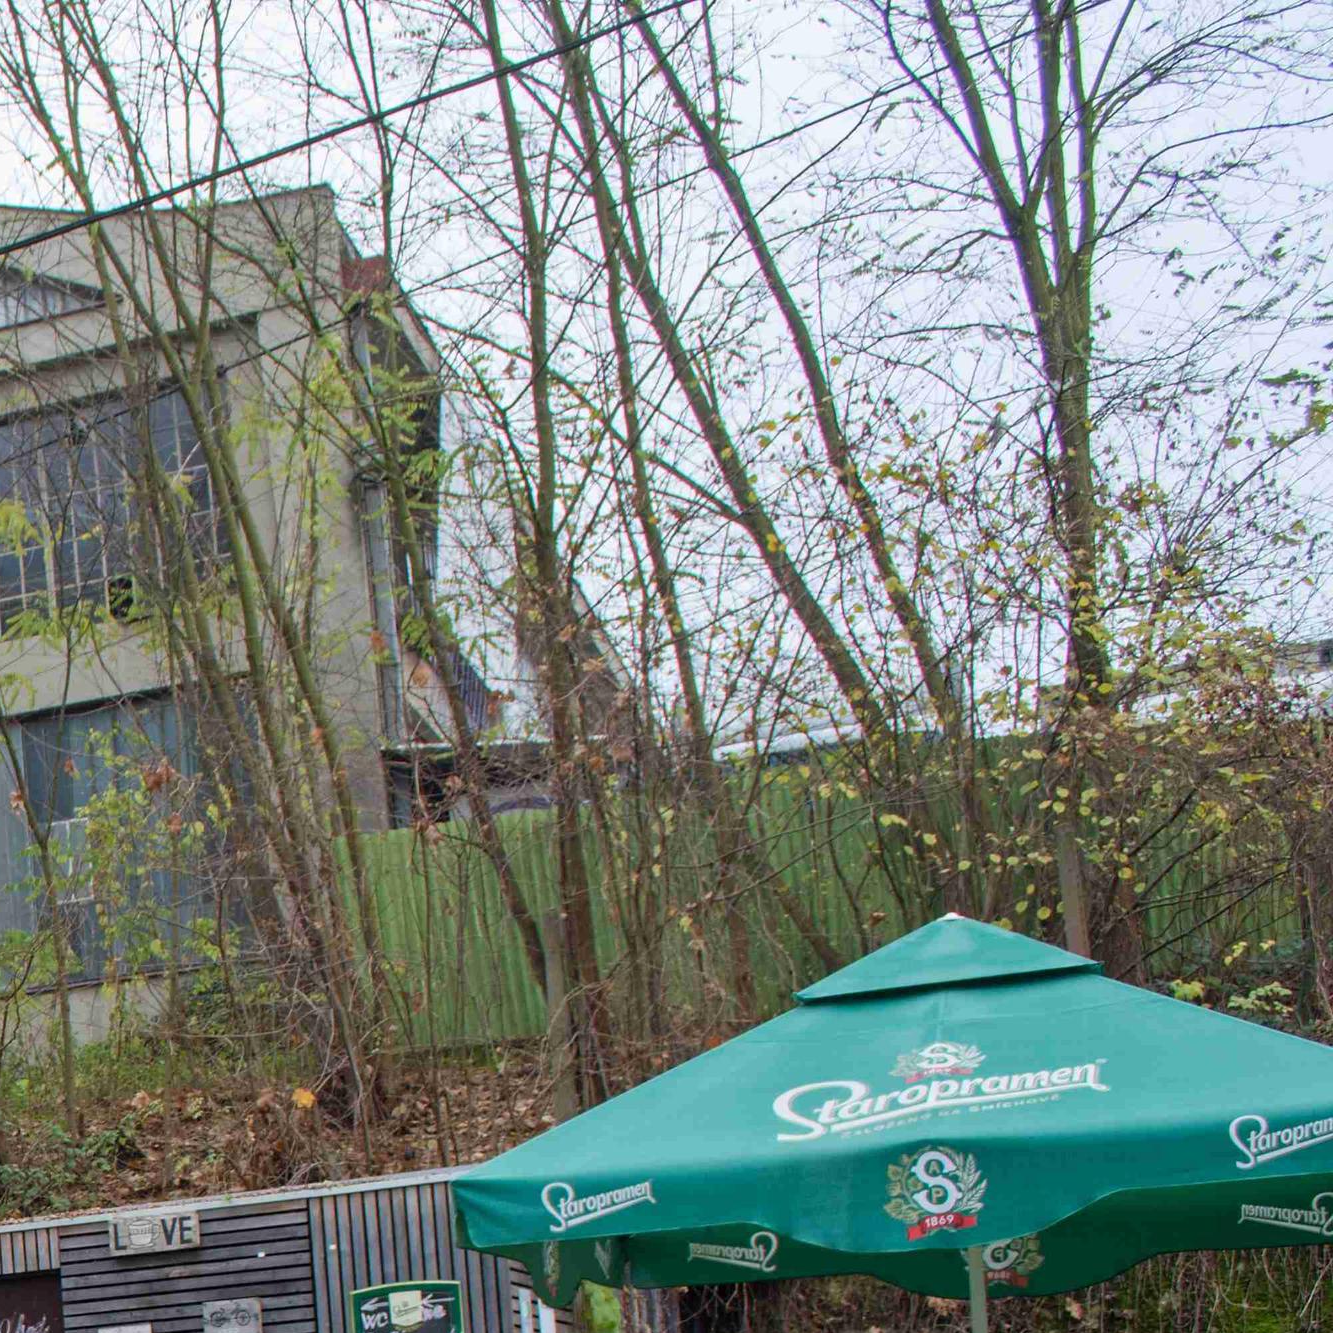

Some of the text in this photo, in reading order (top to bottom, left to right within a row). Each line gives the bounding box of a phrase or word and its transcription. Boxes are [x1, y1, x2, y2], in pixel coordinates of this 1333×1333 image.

[773, 1060, 1111, 1141] Staropramen
[541, 1179, 656, 1232] Staropramen
[925, 1214, 955, 1228] 1869
[360, 1311, 390, 1331] WC
